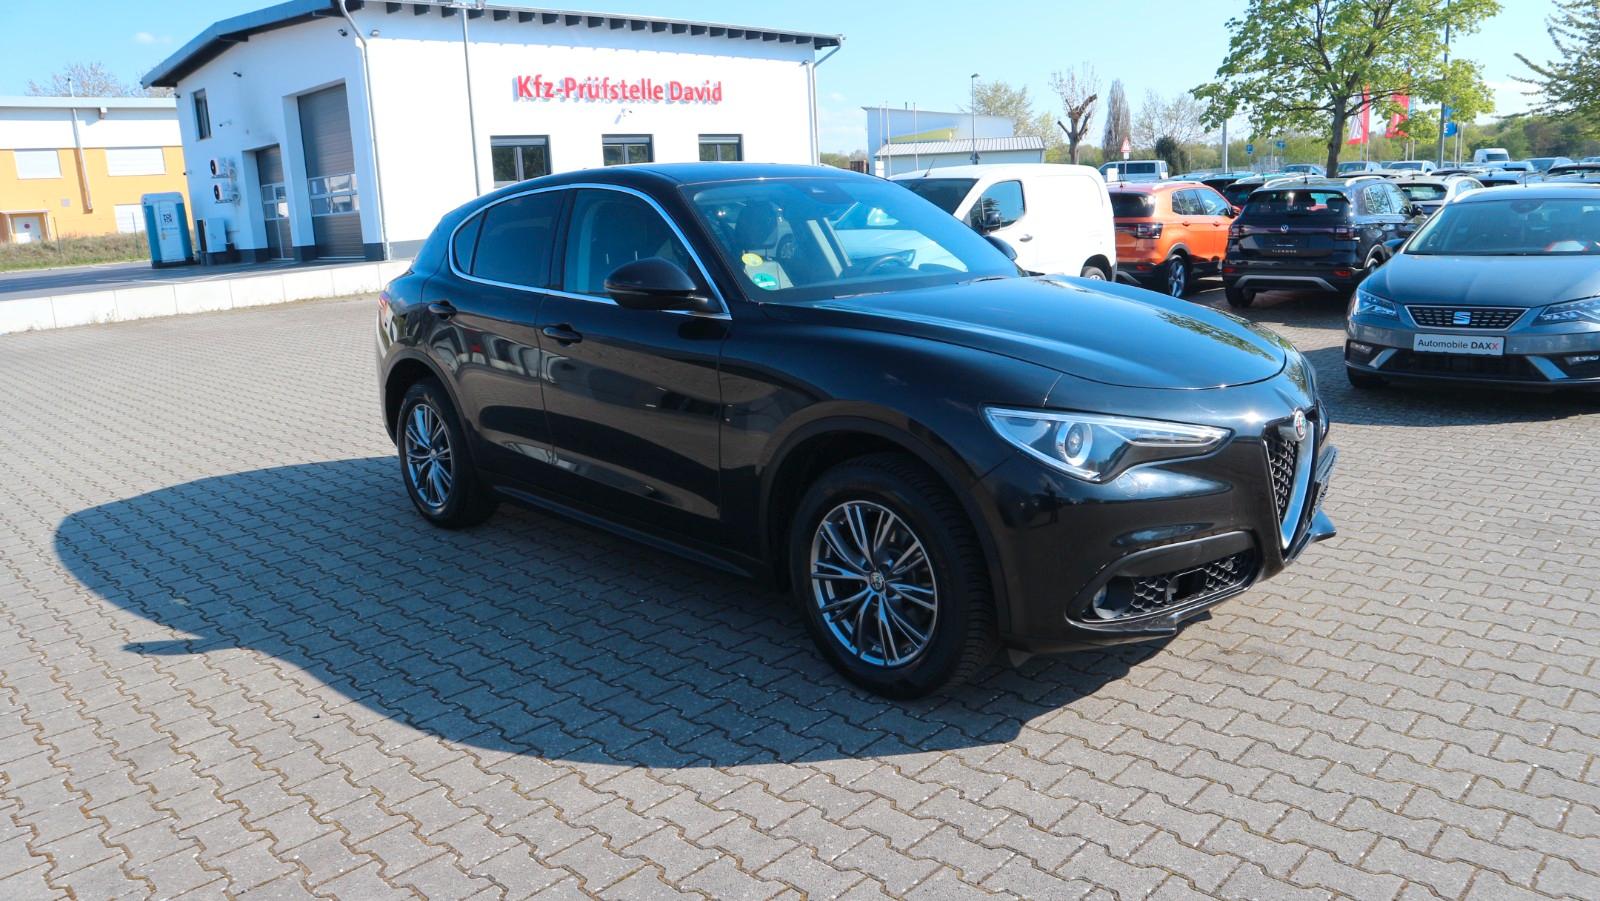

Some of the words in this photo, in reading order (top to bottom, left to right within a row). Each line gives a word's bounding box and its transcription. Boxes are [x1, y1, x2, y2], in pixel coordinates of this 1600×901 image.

[517, 74, 664, 101] Kfz-Prüfstelle
[669, 80, 723, 102] David
[1417, 339, 1469, 349] Automobile
[1470, 341, 1499, 350] DAXX
